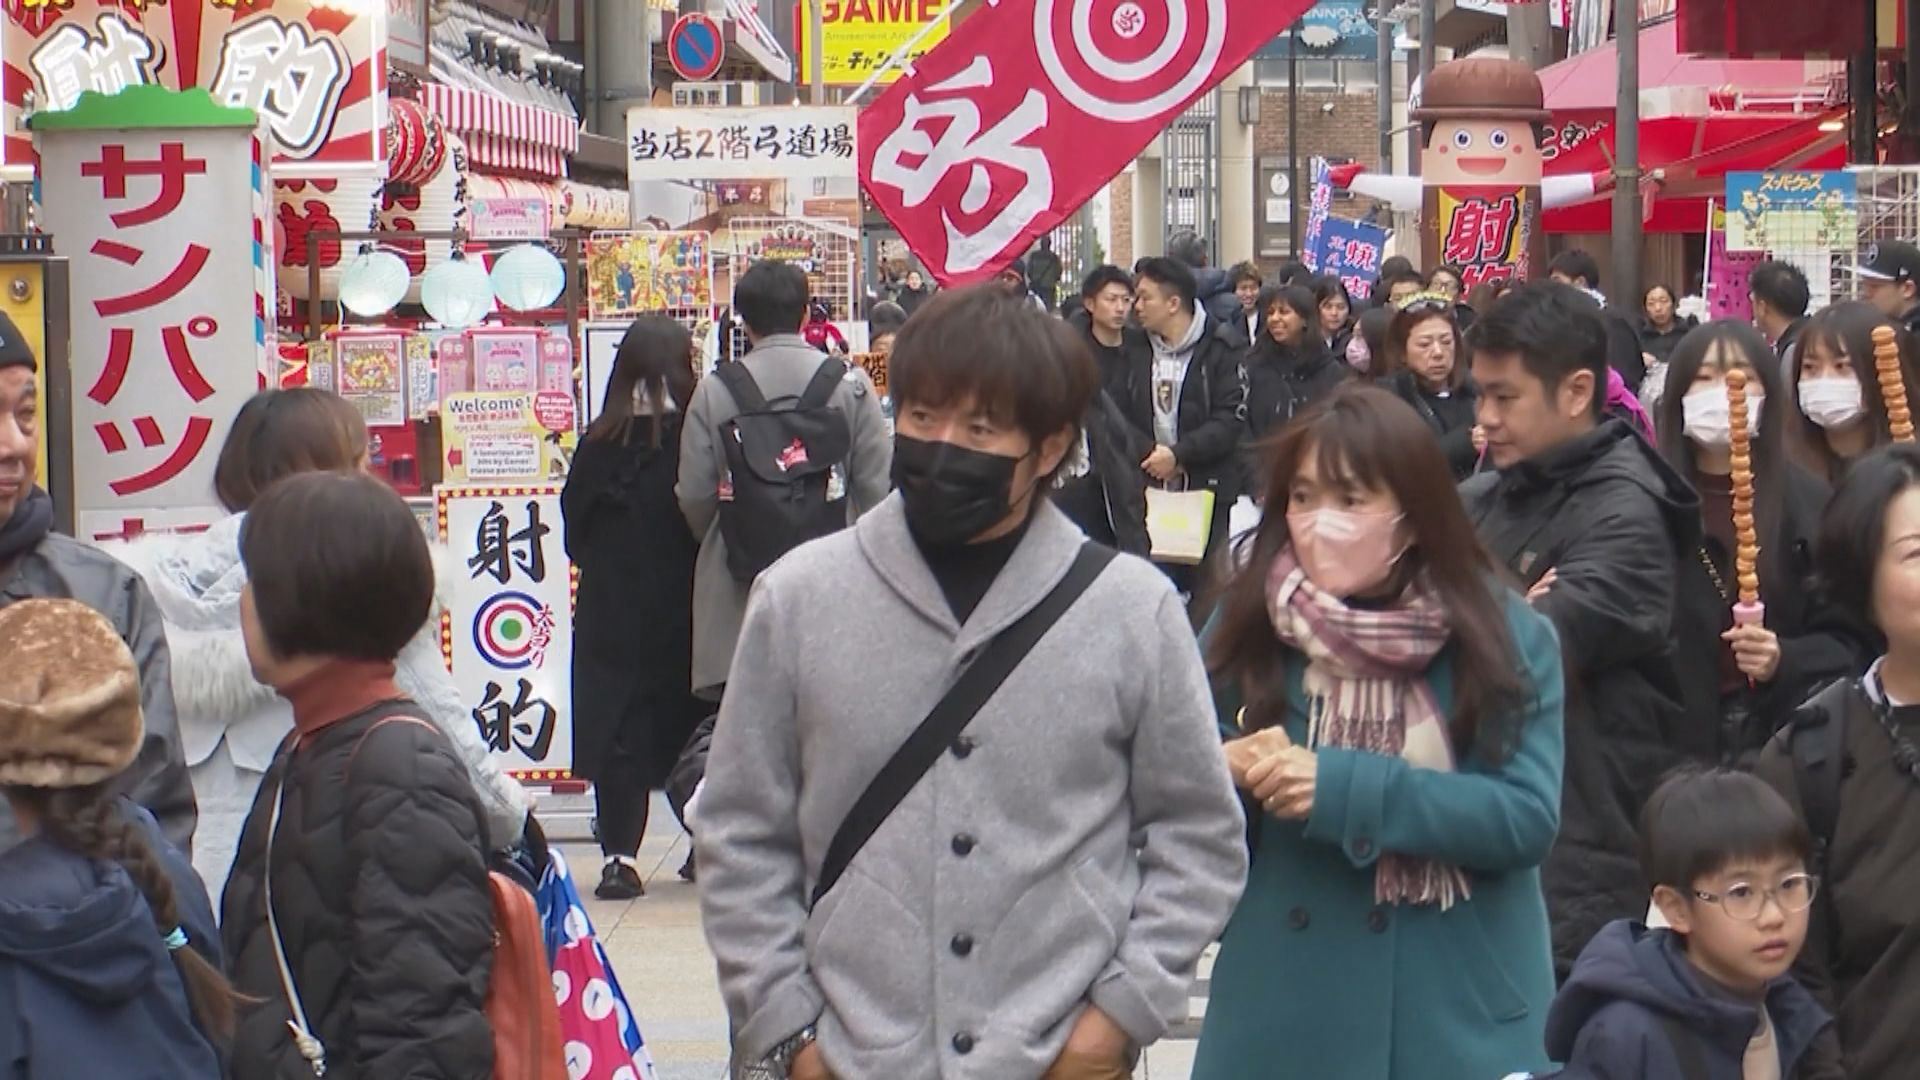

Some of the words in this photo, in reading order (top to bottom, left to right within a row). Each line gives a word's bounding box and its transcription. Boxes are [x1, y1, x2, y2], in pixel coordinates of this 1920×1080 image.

[675, 89, 721, 105] 自動車
[631, 124, 853, 161] 当店2階弓道場
[871, 55, 1053, 273] 的
[81, 142, 218, 541] サンパツ
[450, 396, 531, 413] Welcome!
